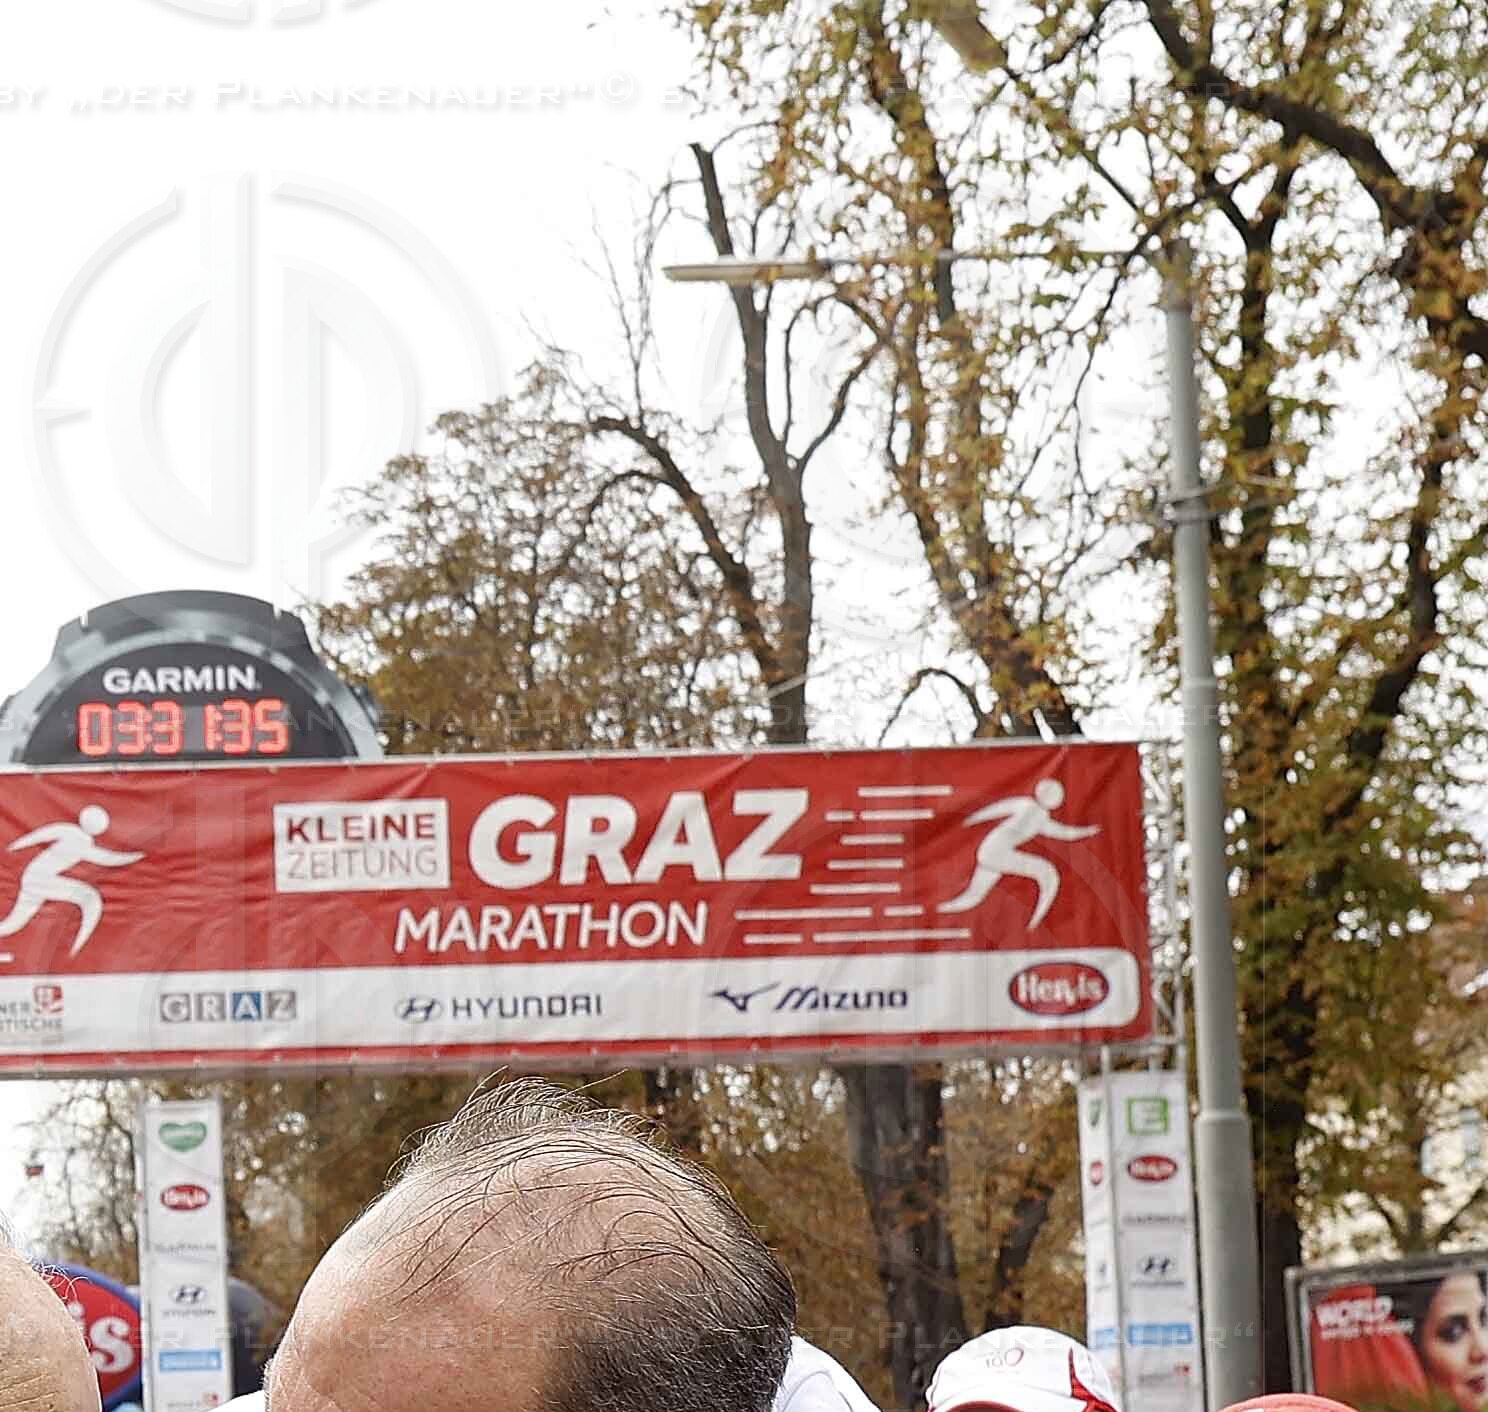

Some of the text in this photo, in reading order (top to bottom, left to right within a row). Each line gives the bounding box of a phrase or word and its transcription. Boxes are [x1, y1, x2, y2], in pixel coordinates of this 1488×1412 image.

[102, 664, 258, 693] GARMIN
[286, 811, 437, 844] KLEINE
[469, 788, 810, 891] GRAZ
[286, 845, 438, 882] ZEITUNG
[394, 900, 709, 954] MARATHON
[160, 990, 298, 1022] GRAZ
[452, 993, 603, 1018] HYUNDAI
